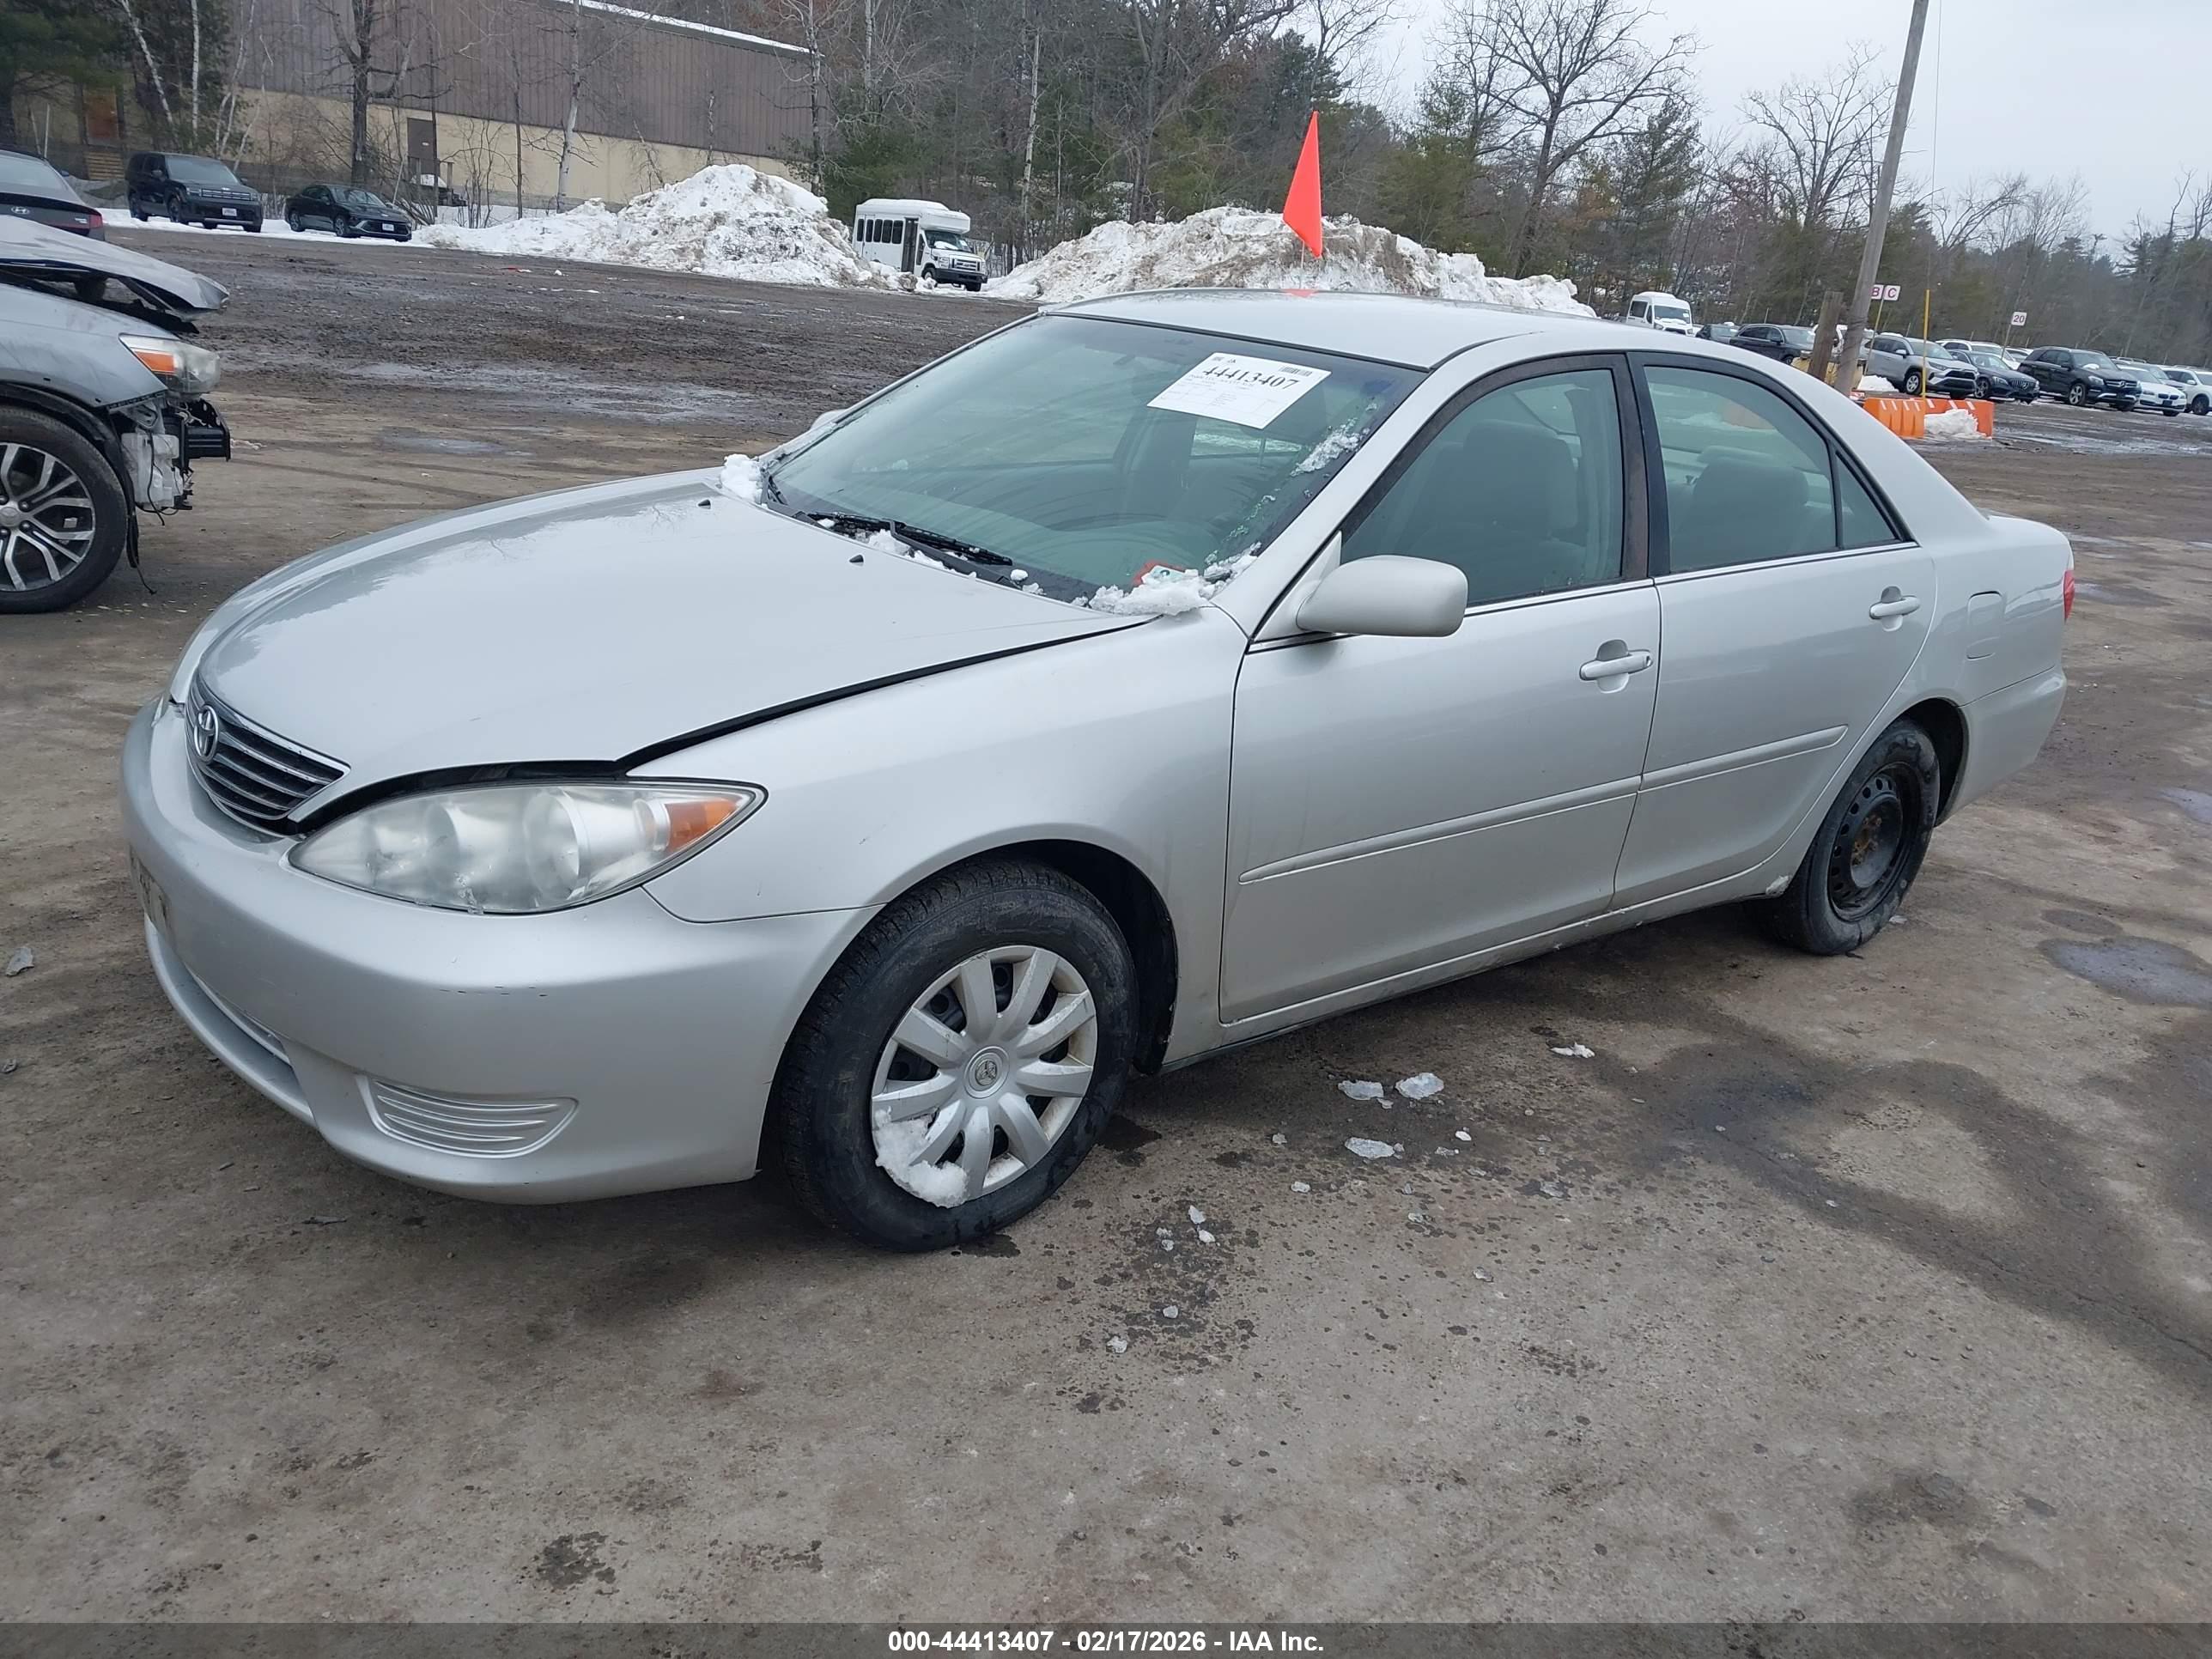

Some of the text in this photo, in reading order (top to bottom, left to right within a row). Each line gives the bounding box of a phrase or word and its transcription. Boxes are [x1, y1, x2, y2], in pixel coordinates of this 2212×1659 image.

[1869, 287, 1881, 297] B
[1887, 288, 1897, 298] C
[2013, 314, 2025, 323] 20
[1203, 366, 1299, 390] 44413407
